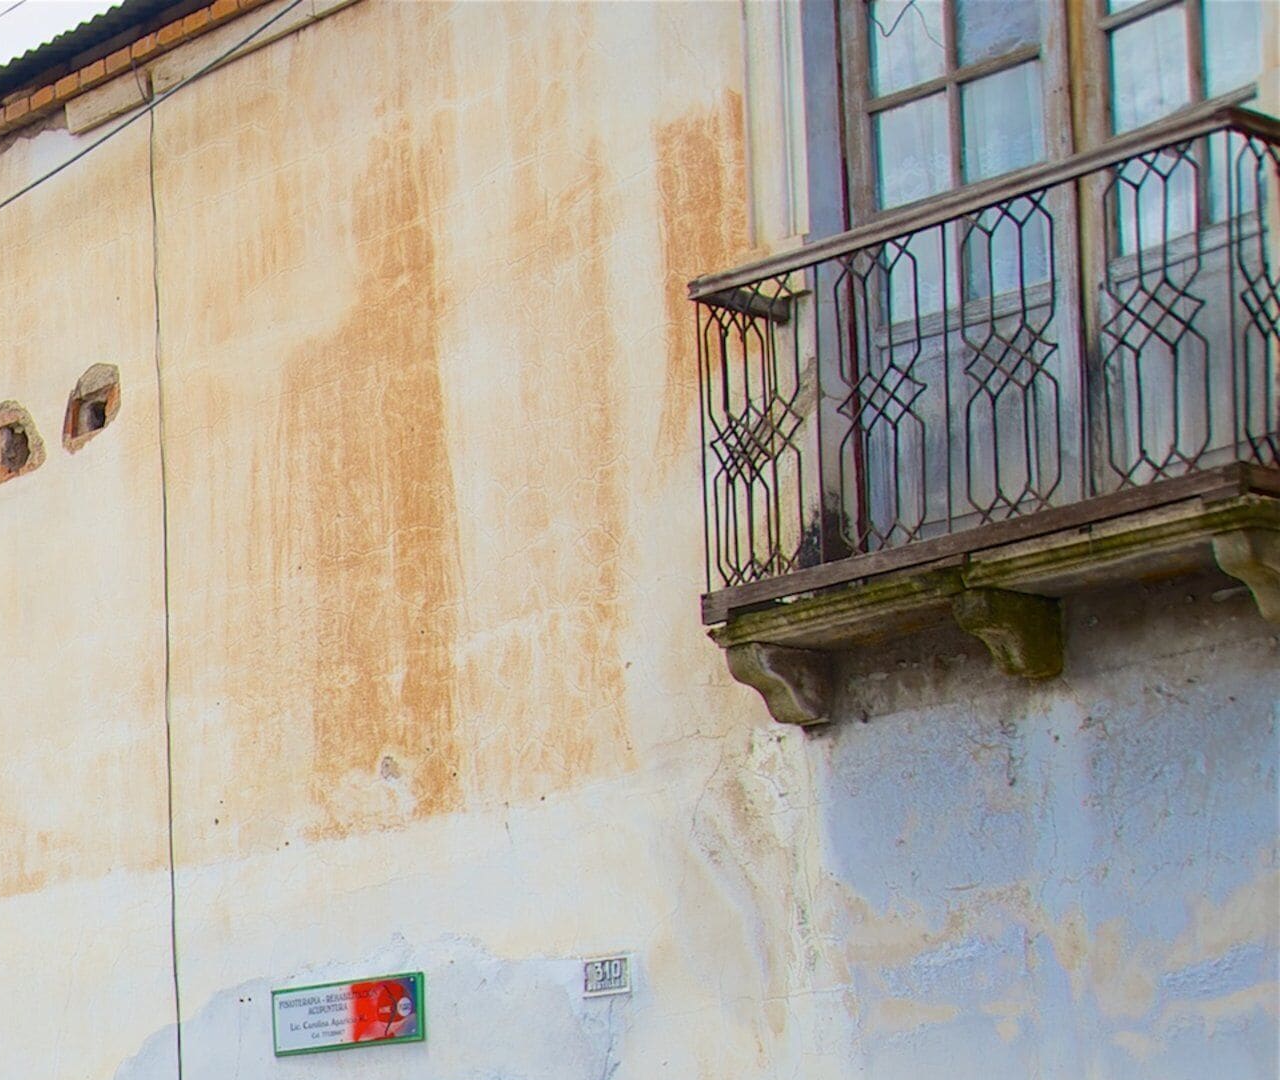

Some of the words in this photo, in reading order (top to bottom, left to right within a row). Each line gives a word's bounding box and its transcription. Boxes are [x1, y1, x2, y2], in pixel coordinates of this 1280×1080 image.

[279, 996, 321, 1010] FISIOTERAPIA
[308, 1003, 348, 1015] ACUPUNTURA
[303, 1020, 329, 1030] Carolina
